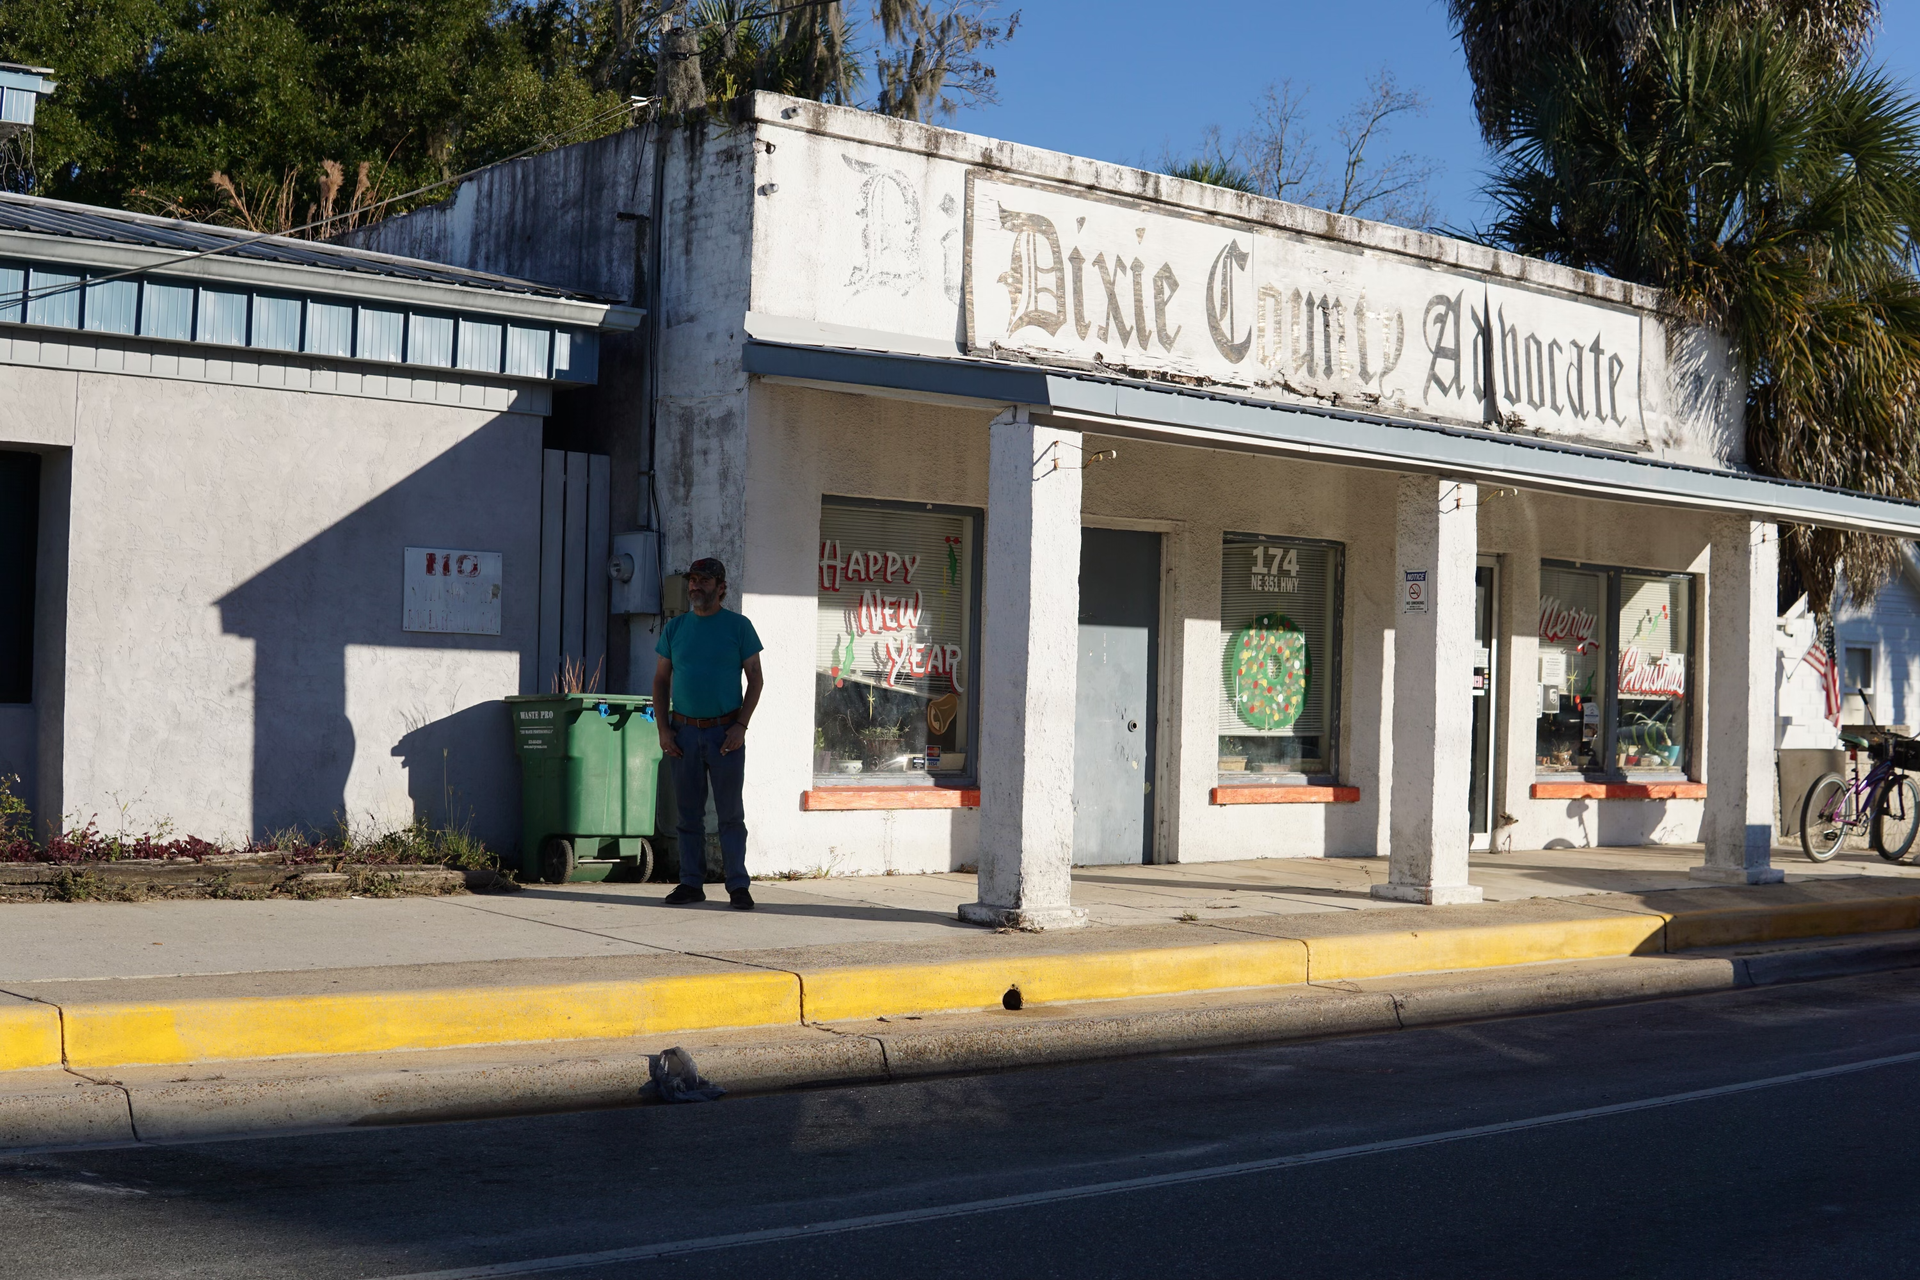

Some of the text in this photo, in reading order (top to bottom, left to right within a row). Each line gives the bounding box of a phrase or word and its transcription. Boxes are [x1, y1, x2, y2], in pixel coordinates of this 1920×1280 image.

[996, 200, 1627, 428] Dixie County Advocate
[426, 552, 481, 578] NO
[820, 539, 920, 592] HAPPY
[1252, 546, 1299, 576] 174
[1406, 572, 1425, 581] NOTICE
[1251, 574, 1299, 593] NE 351 HWY
[858, 589, 923, 634] NEW
[1539, 594, 1600, 656] Merry
[886, 637, 964, 696] YEAR
[520, 710, 554, 719] WASTE PRO
